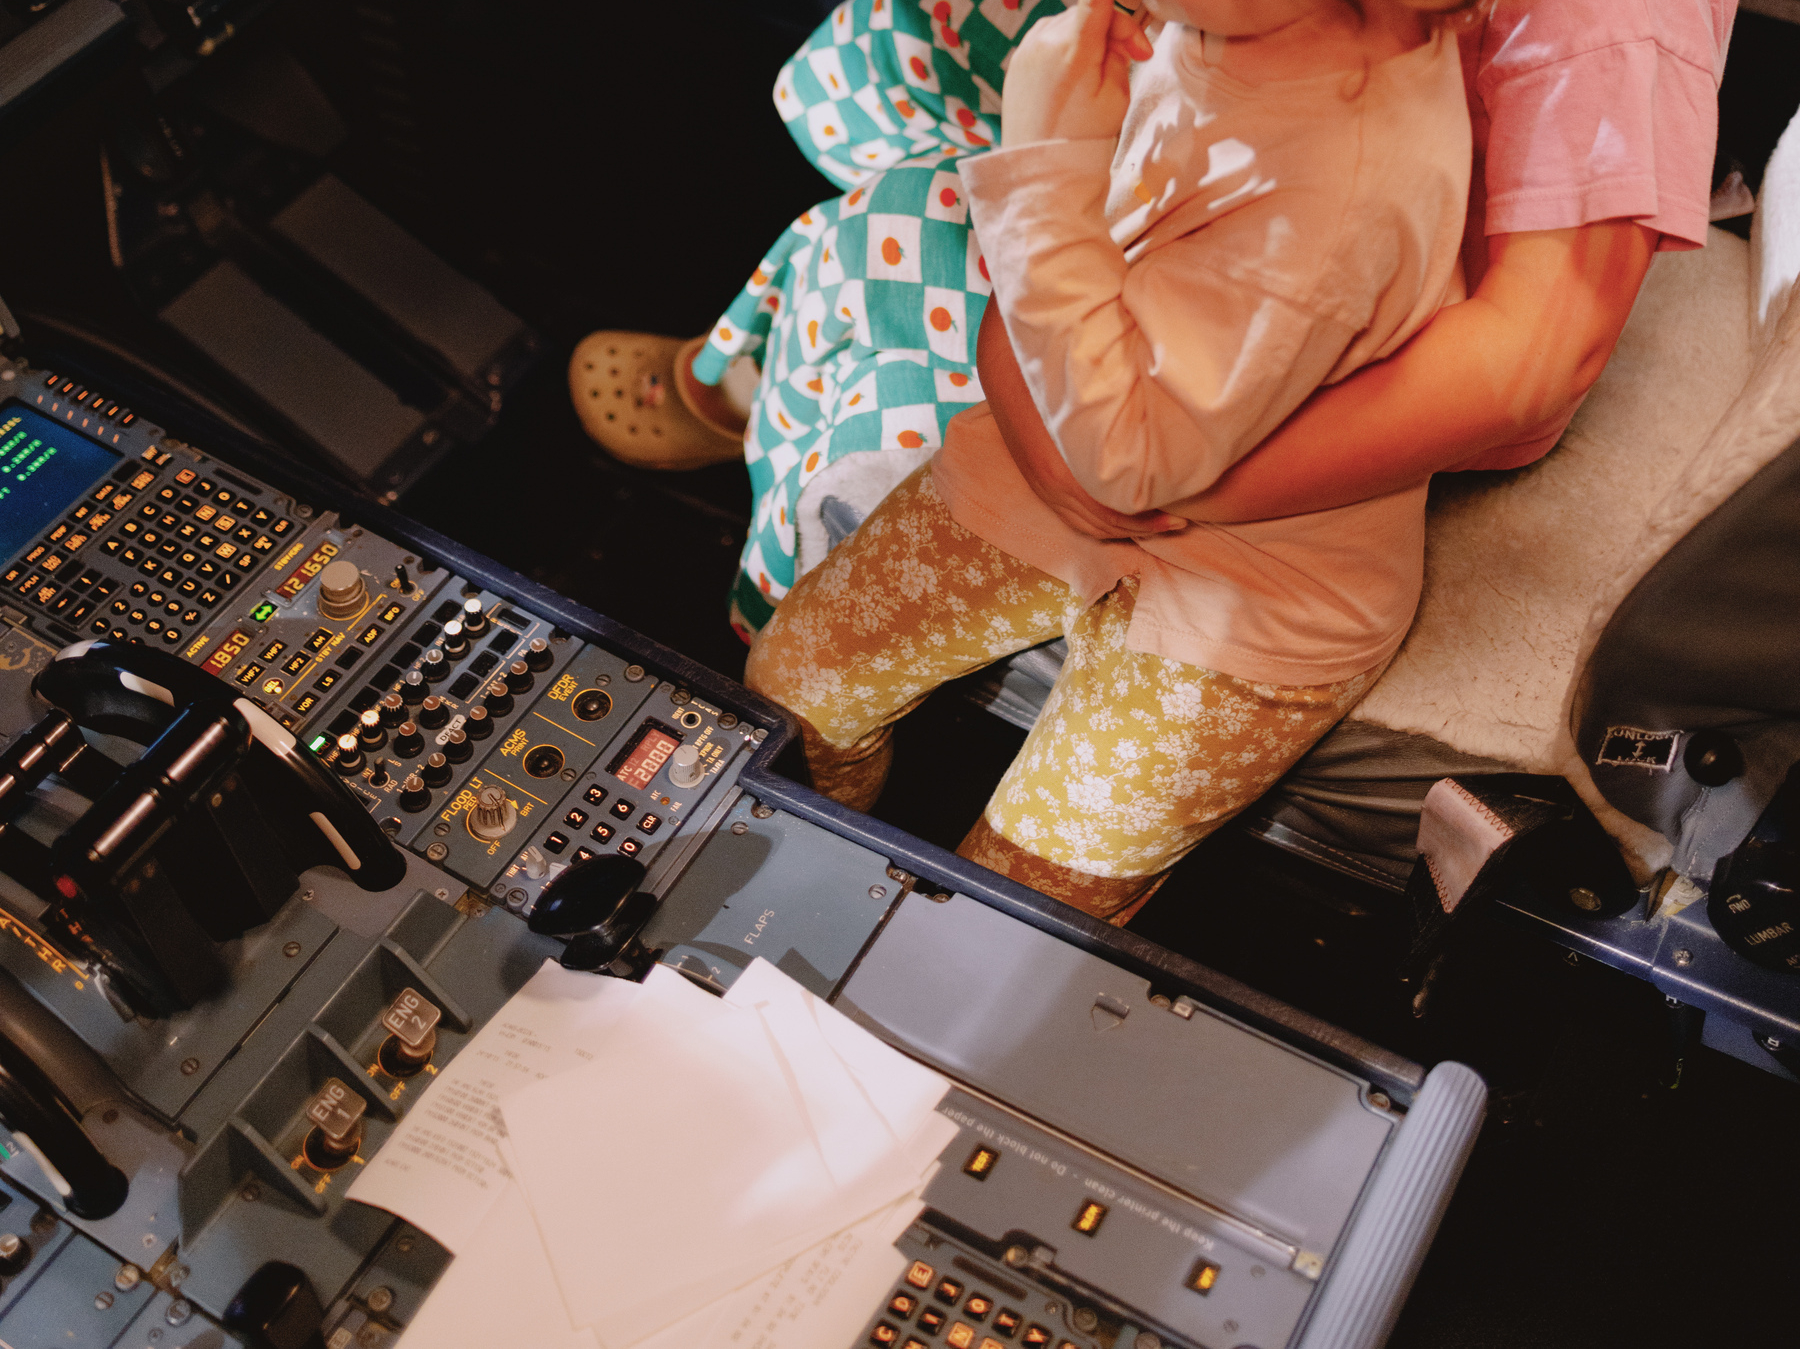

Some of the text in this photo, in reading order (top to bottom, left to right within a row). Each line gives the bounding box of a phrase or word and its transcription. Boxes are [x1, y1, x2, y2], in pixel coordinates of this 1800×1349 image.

[200, 482, 211, 490] J
[161, 489, 173, 498] D
[143, 506, 155, 515] C
[237, 501, 248, 510] T
[162, 515, 175, 525] H
[256, 511, 267, 520] Y
[50, 525, 67, 541] PERF
[181, 525, 195, 536] M
[238, 528, 251, 538] X
[107, 541, 119, 551] A
[200, 536, 213, 545] R
[26, 546, 45, 563] PROG
[124, 550, 135, 560] F
[163, 544, 175, 552] L
[144, 560, 157, 570] K
[238, 554, 251, 567] SP
[201, 564, 213, 572] V
[163, 571, 173, 581] P
[133, 584, 144, 593] 3
[183, 581, 195, 591] U
[151, 593, 163, 602] 6
[202, 592, 216, 602] Z
[115, 602, 126, 611] 2
[168, 603, 179, 611] 9
[383, 606, 400, 621] BFO
[131, 612, 143, 620] 5
[96, 621, 106, 629] 1
[149, 621, 160, 629] 8
[113, 631, 123, 639] 4
[312, 635, 326, 648] AM
[363, 628, 378, 643] ADF
[435, 637, 446, 647] INT
[186, 635, 211, 658] ACTIVE
[264, 642, 283, 661] VHF3
[315, 632, 346, 663] STBY NAV
[288, 657, 305, 672] HF2
[240, 665, 261, 684] VHF2
[321, 676, 334, 687] LS
[263, 680, 279, 694] SEL
[547, 673, 575, 700] DFDR
[558, 681, 579, 702] EVENT
[298, 697, 314, 712] VOR
[438, 695, 459, 710] MKR
[690, 700, 719, 717] TCAS
[671, 706, 686, 720] IDENT
[703, 725, 715, 735] OFF
[500, 728, 527, 757] ACMS
[510, 737, 530, 757] PRINT
[633, 740, 675, 783] 2000
[706, 745, 724, 764] TA ONLY
[361, 767, 373, 778] INT
[619, 766, 633, 782] ATC
[709, 759, 726, 775] TA/RA
[384, 779, 398, 793] RAD
[591, 788, 602, 798] 3
[440, 776, 484, 821] FLOOD LT
[649, 789, 662, 801] ATC
[462, 796, 477, 812] PED
[519, 802, 535, 817] BRT
[618, 803, 629, 813] 6
[670, 801, 683, 813] FAIL
[571, 812, 583, 822] 2
[642, 815, 657, 829] CLR
[598, 826, 609, 836] 5
[551, 836, 564, 844] 1
[624, 842, 636, 851] 0
[486, 840, 501, 856] OFF
[579, 850, 590, 860] 4
[1728, 899, 1751, 914] FWD
[743, 908, 776, 945] FLAPS
[1744, 922, 1795, 945] LUMBAR
[711, 966, 721, 975] 2
[387, 993, 419, 1029] ENG
[411, 1014, 427, 1030] 2
[425, 1063, 438, 1076] 2
[389, 1081, 406, 1101] OFF
[312, 1084, 345, 1123] ENG
[337, 1107, 352, 1122] 1
[941, 1107, 975, 1131] paper
[976, 1121, 995, 1140] the
[997, 1133, 1029, 1157] block
[290, 1155, 305, 1170] ON
[352, 1154, 365, 1165] 1
[1029, 1149, 1049, 1164] not
[1050, 1161, 1067, 1176] Do
[314, 1173, 331, 1195] OFF
[1084, 1177, 1116, 1198] clean
[1117, 1195, 1161, 1222] printer
[1161, 1215, 1182, 1234] the
[1184, 1227, 1215, 1252] Keep
[942, 1282, 955, 1297] J
[894, 1296, 910, 1312] D
[999, 1313, 1016, 1328] T
[877, 1325, 894, 1342] C
